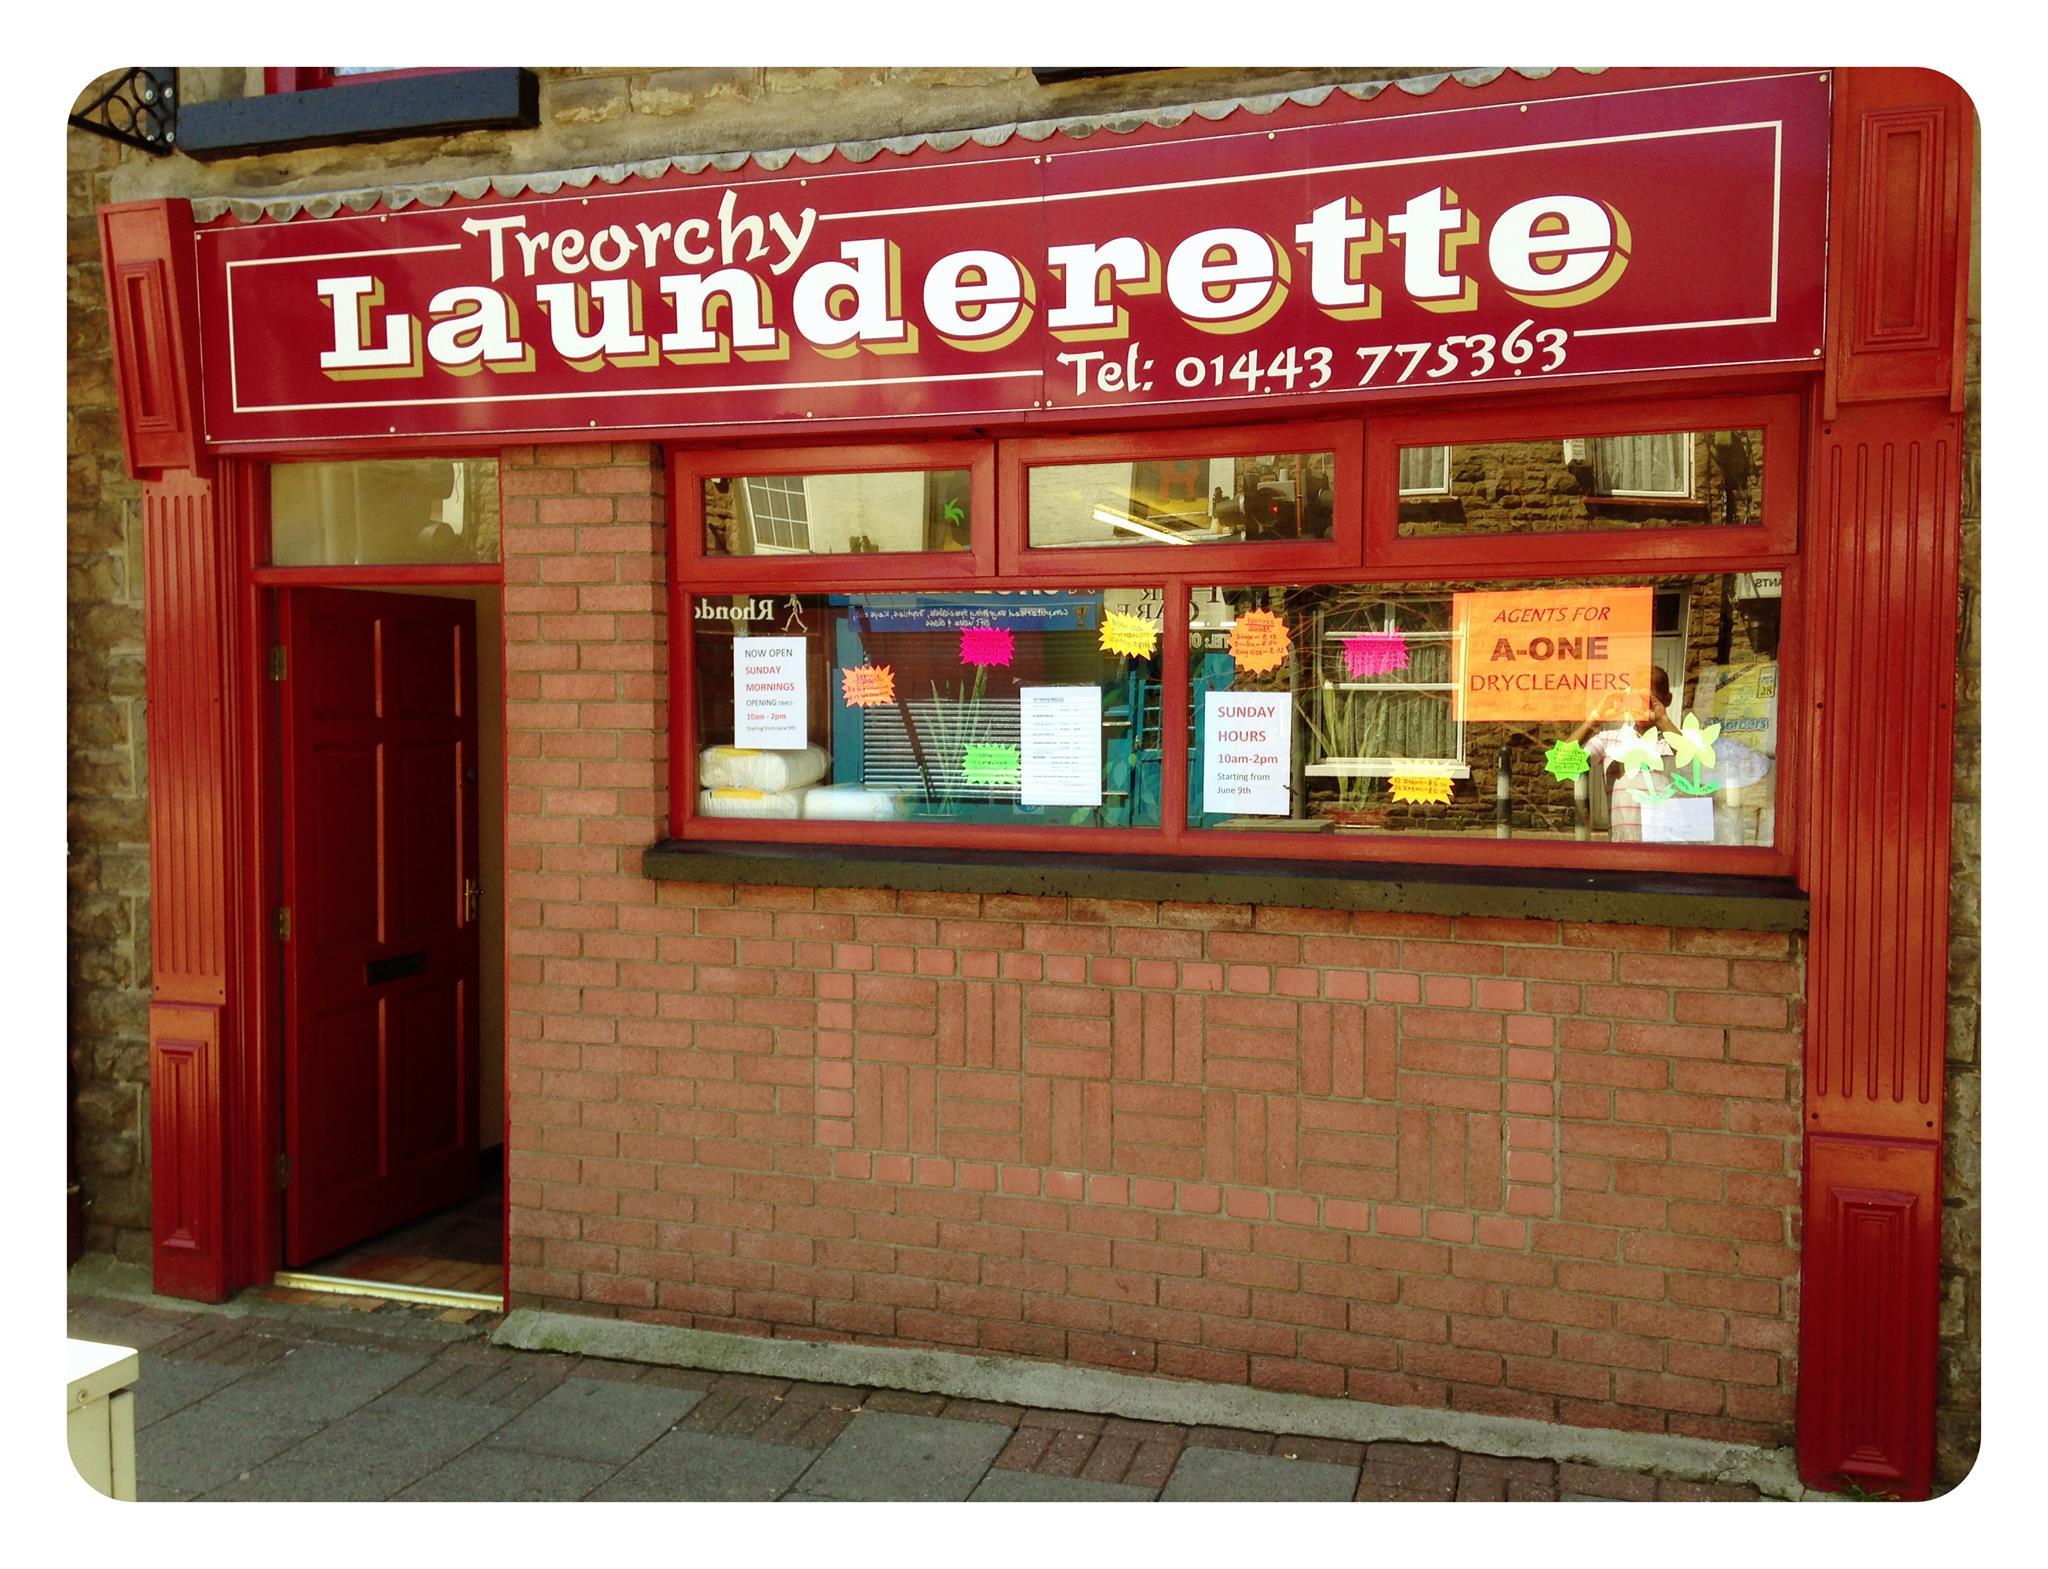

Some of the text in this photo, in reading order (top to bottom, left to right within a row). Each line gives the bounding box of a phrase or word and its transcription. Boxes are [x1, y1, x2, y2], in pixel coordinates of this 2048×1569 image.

[461, 188, 818, 283] Treorchy
[317, 184, 1630, 381] Launderette
[1057, 318, 1569, 399] Tel: 01443 775363
[1493, 605, 1611, 623] AGENTS FOR
[744, 648, 793, 658] NOW OPEN
[1490, 635, 1609, 662] A-ONE
[744, 665, 782, 675] SUNDAY
[745, 682, 796, 692] MORNINGS
[1470, 672, 1631, 692] DRYCLEANERS
[1760, 685, 1773, 696] 28
[745, 698, 777, 707] OPENING
[746, 713, 765, 721] 10am
[770, 713, 787, 722] 2pm
[1217, 705, 1276, 719] SUNDAY
[1217, 729, 1267, 743] HOURS
[1217, 753, 1279, 766] 10am-2pm
[1217, 772, 1271, 783] Starting from
[1217, 785, 1252, 796] June 9th
